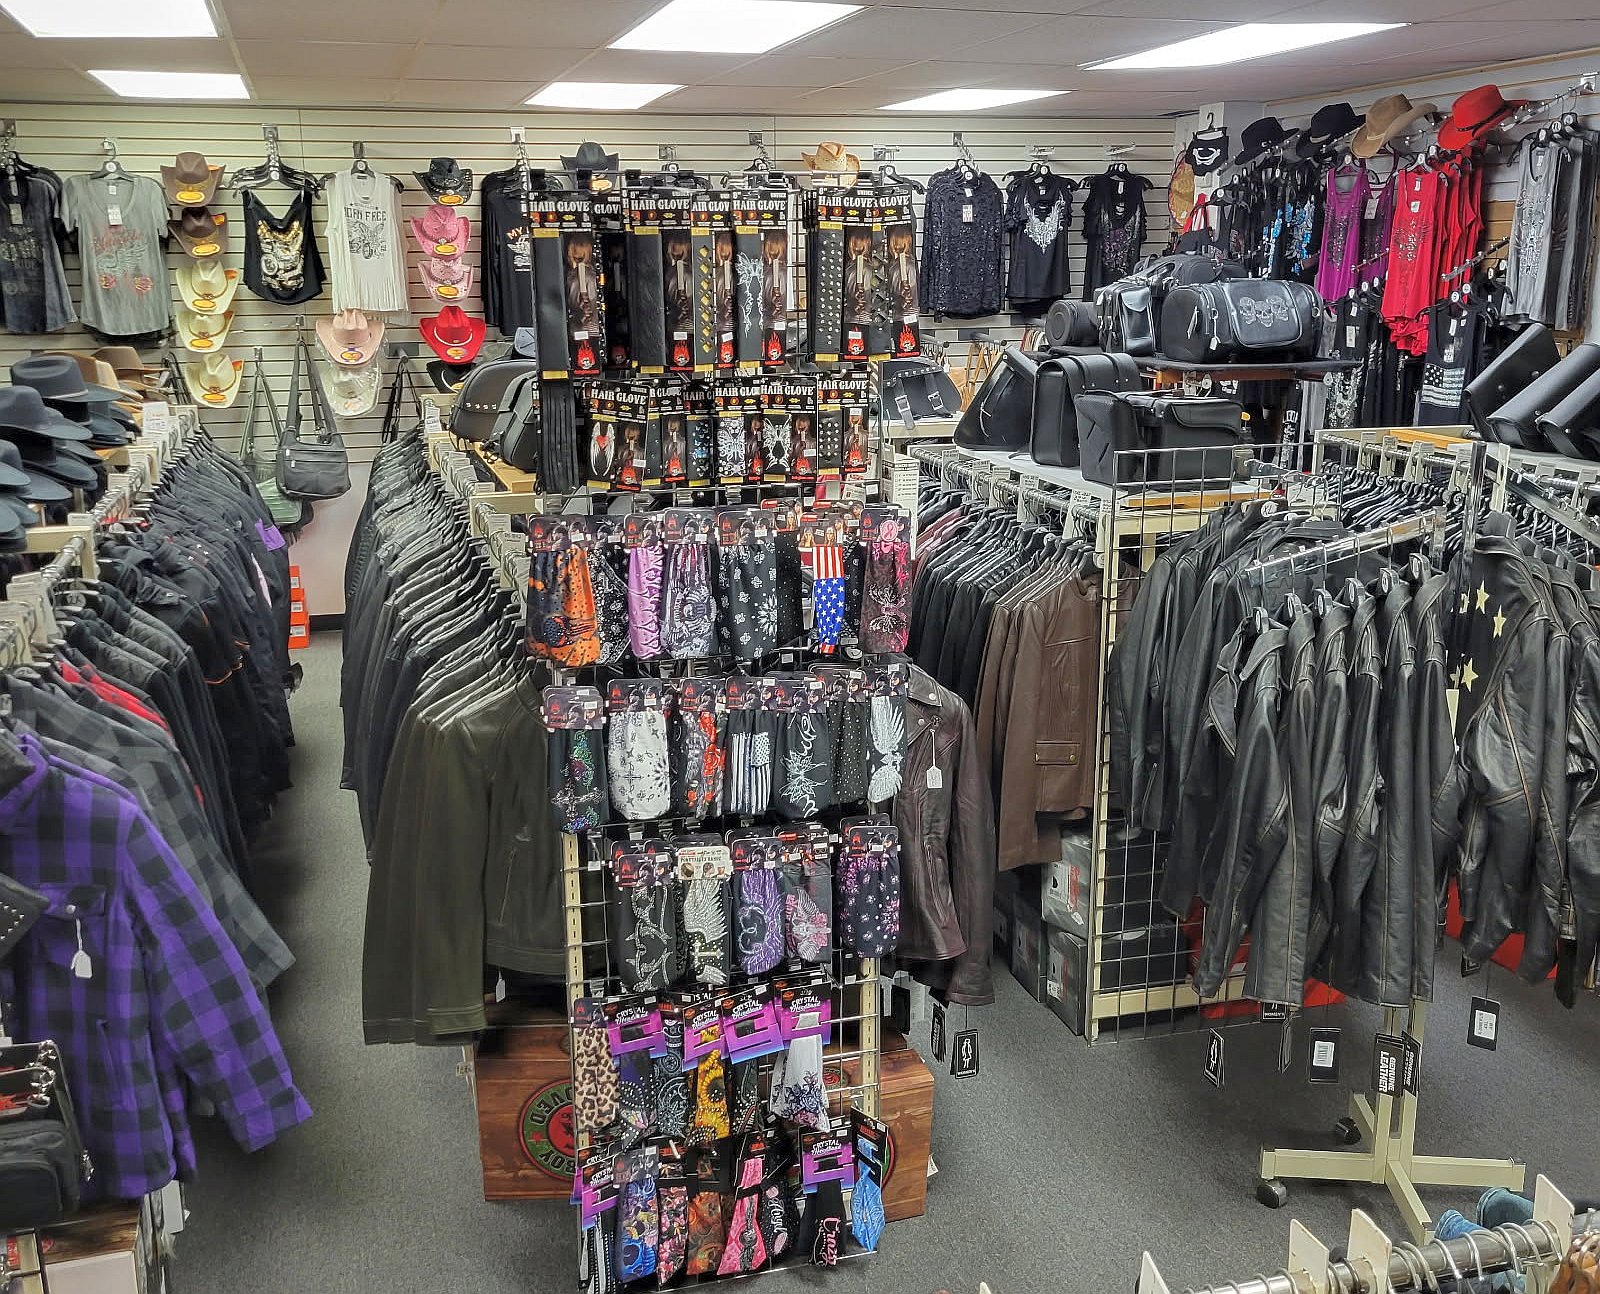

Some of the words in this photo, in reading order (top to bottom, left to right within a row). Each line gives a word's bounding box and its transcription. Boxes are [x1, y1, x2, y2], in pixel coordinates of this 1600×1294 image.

[529, 201, 556, 212] HAIR
[558, 201, 590, 212] GLOVE
[631, 200, 656, 210] HAIR
[658, 200, 690, 210] GLOVE
[691, 201, 708, 212] AIR
[709, 201, 730, 212] GLOV
[733, 200, 756, 210] HAIR
[758, 200, 786, 211] GLOVE
[818, 195, 842, 206] HAIR
[843, 197, 873, 208] GLOVE
[879, 195, 910, 207] GLOVE
[594, 204, 621, 215] GLOV
[761, 385, 783, 394] HAIR
[784, 385, 815, 396] GLOVE
[817, 379, 839, 390] HAIR
[839, 380, 868, 390] GLOVE
[591, 388, 615, 401] HAIR
[616, 392, 648, 405] GLOVE
[715, 387, 739, 397] HAIR
[732, 1000, 761, 1014] CRYSTAL
[791, 996, 819, 1007] CRYSTAL
[693, 1010, 717, 1024] CRYSTAL
[1379, 1051, 1390, 1093] LEATHER
[1388, 1057, 1397, 1092] GENUINE
[1406, 1052, 1415, 1087] GENUINE
[812, 1139, 840, 1151] CRYSTAL
[821, 1217, 841, 1266] Crazy
